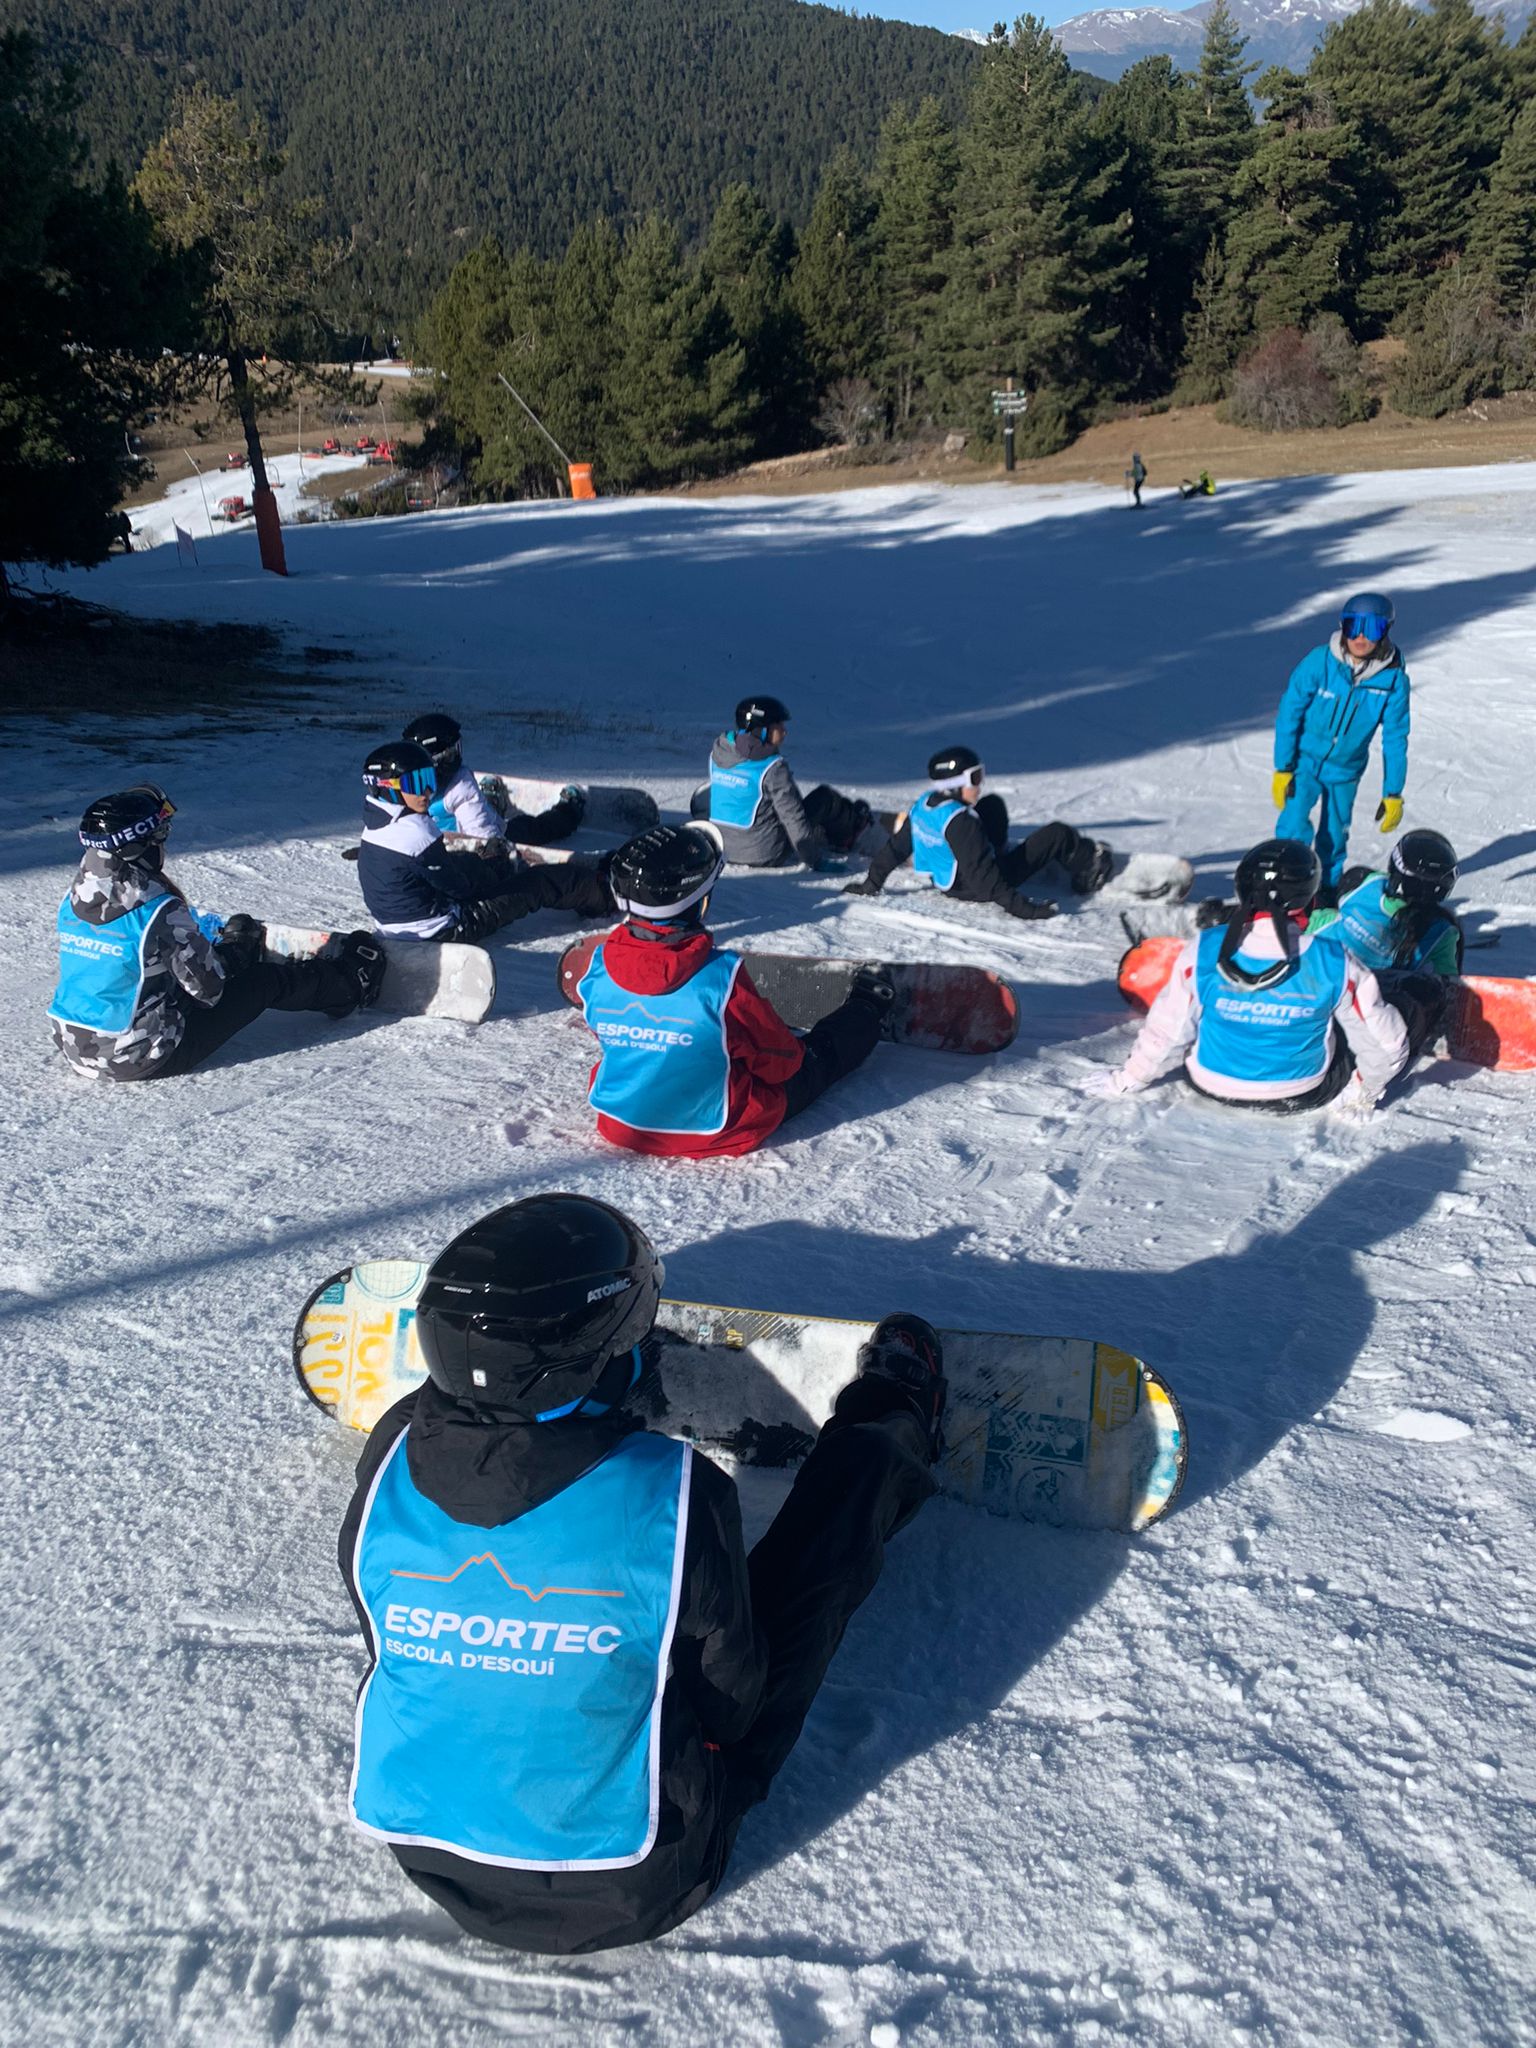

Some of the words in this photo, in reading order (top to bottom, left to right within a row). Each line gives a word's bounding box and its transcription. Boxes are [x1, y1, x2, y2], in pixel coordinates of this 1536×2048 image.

[1215, 997, 1315, 1019] ESPORTEC
[596, 1022, 693, 1046] ESPORTEC
[587, 1278, 632, 1303] ATOMIC
[384, 1603, 622, 1655] ESPORTEC
[385, 1638, 454, 1667] ESCOLA
[460, 1653, 555, 1677] D'ESQUÍ
